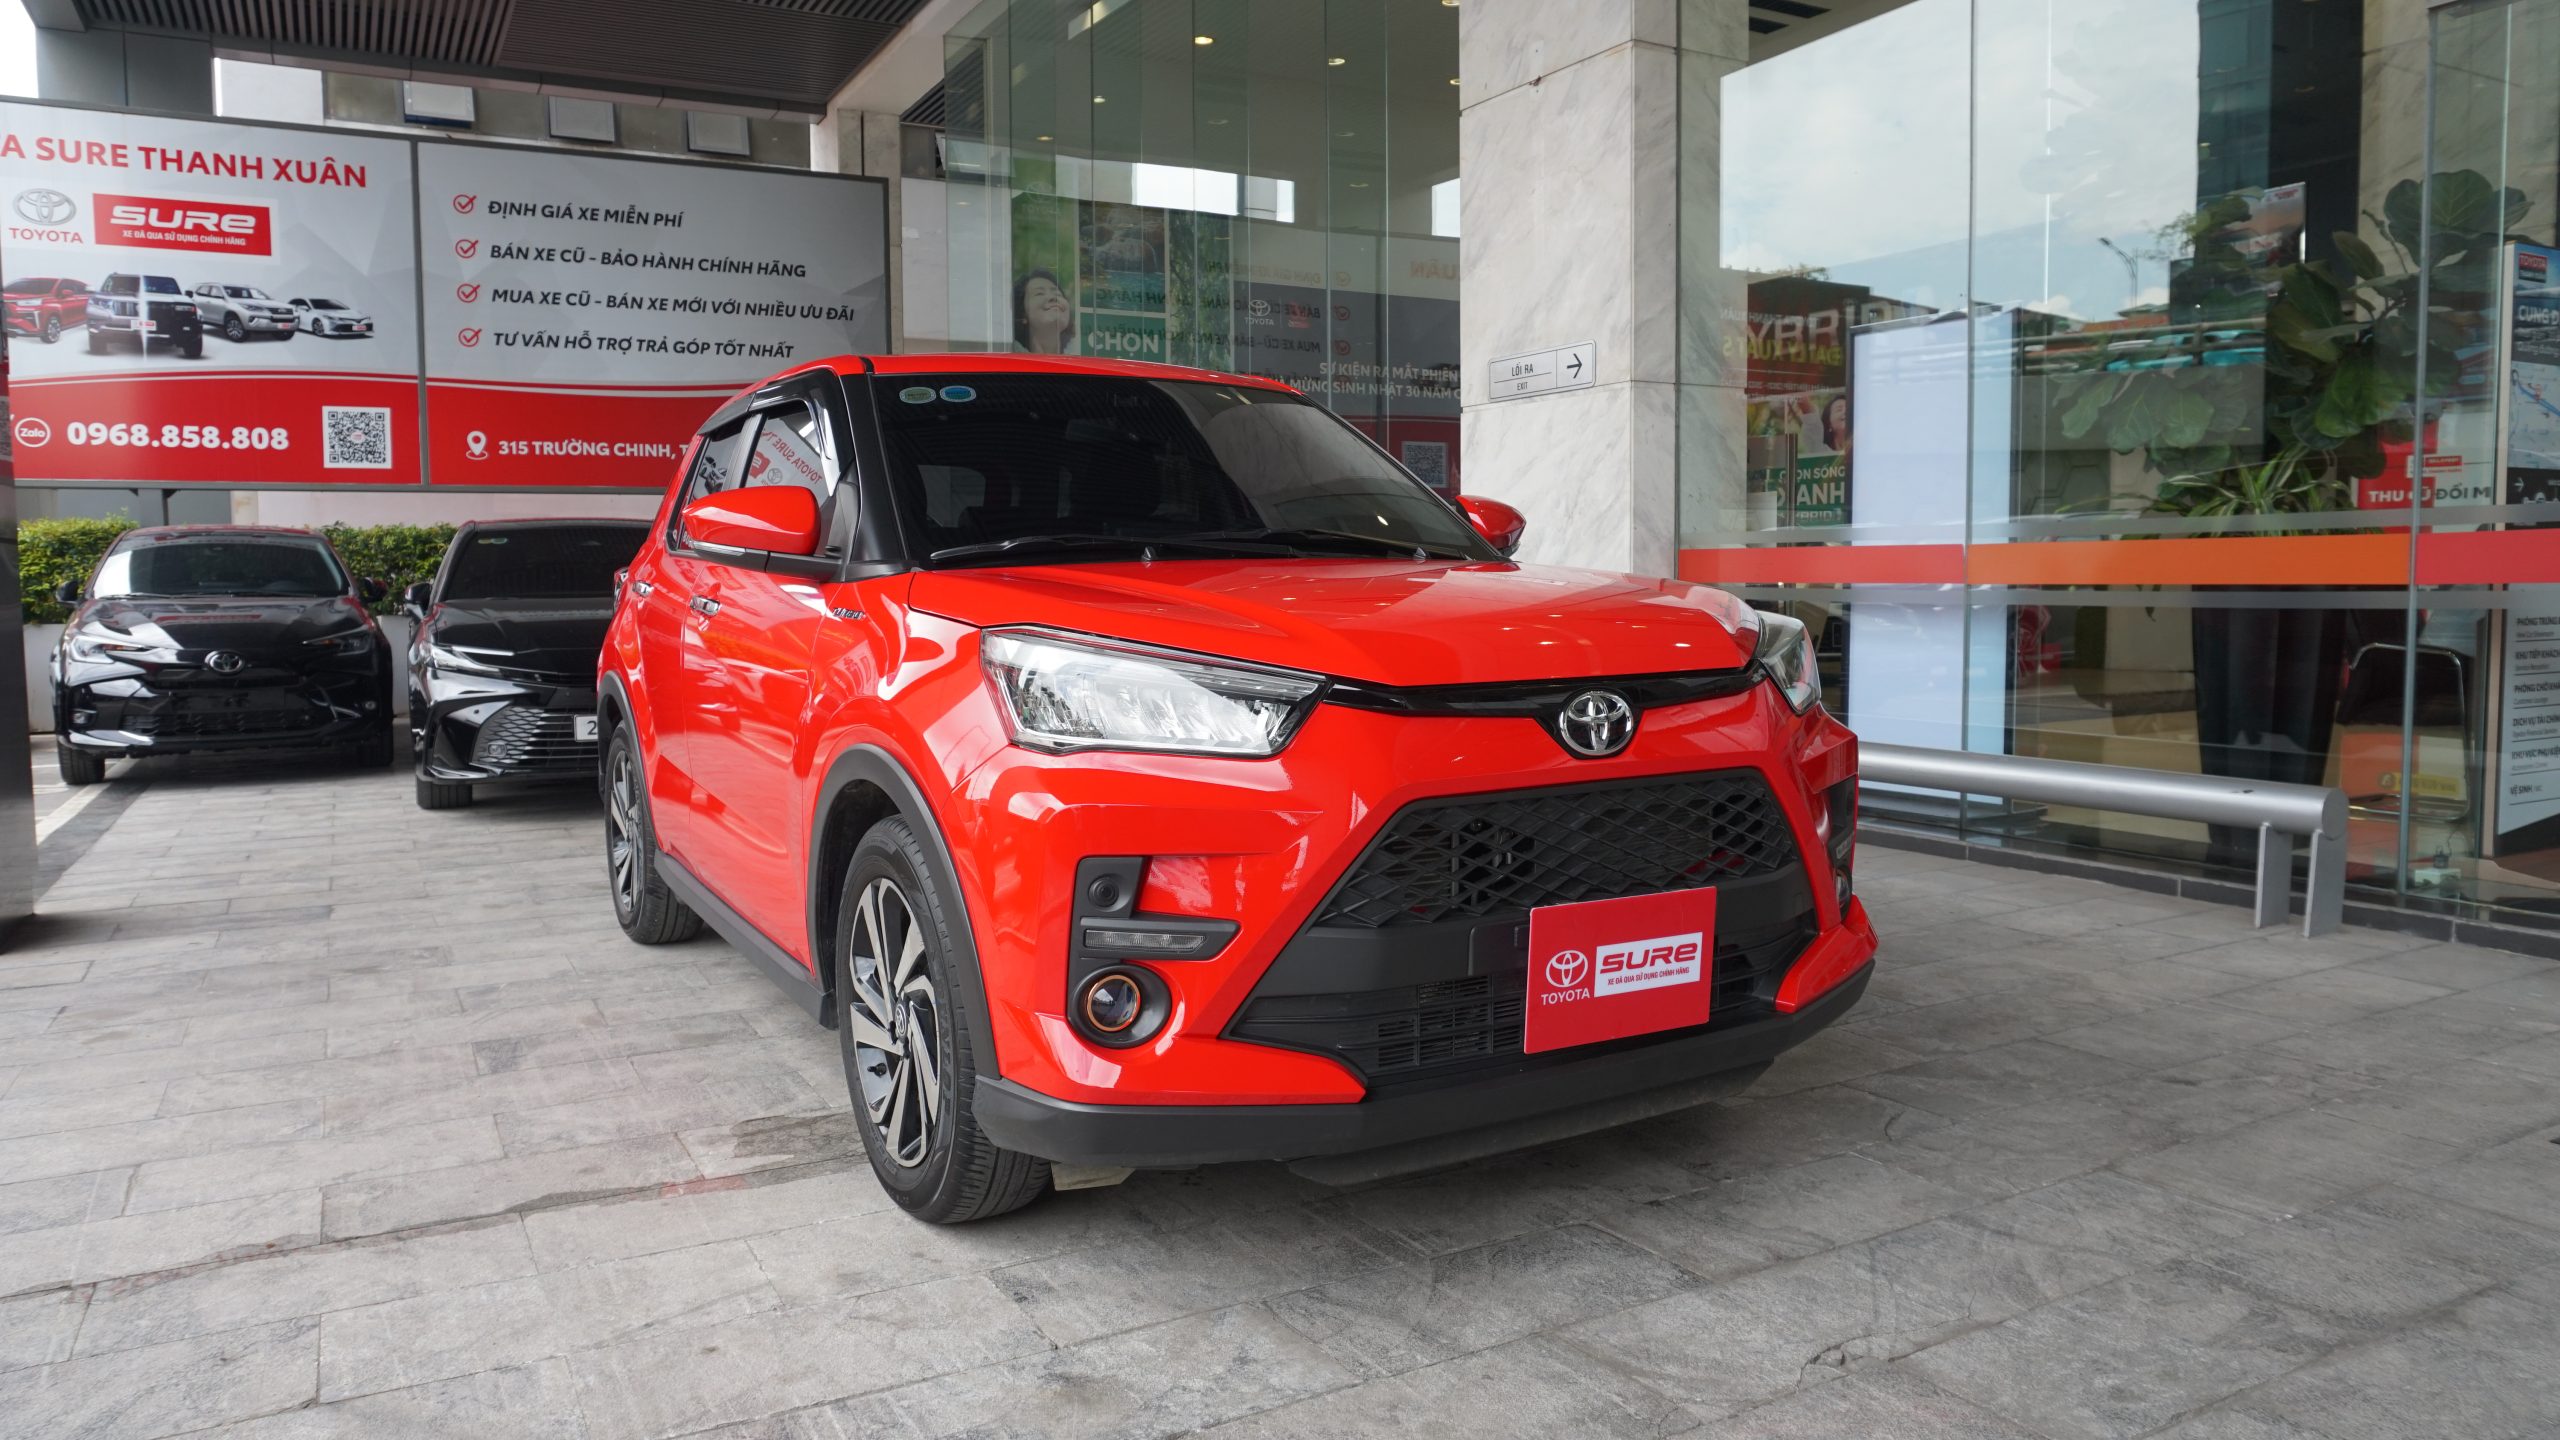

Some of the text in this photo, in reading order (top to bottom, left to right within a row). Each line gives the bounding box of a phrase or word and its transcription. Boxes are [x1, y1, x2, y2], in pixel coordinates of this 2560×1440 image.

[0, 134, 367, 188] A SURE THANH XUÂN
[488, 200, 685, 228] ĐỊNH GIÁ XE MIỄN PHÍ
[9, 227, 84, 245] TOYOTA
[122, 230, 133, 238] XE
[147, 231, 163, 240] QUA
[490, 242, 530, 261] BÁN
[533, 247, 556, 262] XE
[560, 246, 585, 264] CŨ
[600, 248, 638, 267] BẢO
[642, 252, 694, 271] HÀNH
[698, 256, 753, 275] CHÍNH
[757, 260, 806, 278] HÃNG
[491, 288, 535, 304] MUA
[538, 291, 562, 306] XE
[565, 290, 591, 307] CŨ
[606, 292, 643, 310] BÁN
[647, 297, 668, 311] XE
[672, 296, 707, 313] MỚI
[711, 298, 741, 315] VỚI
[744, 299, 796, 318] NHIỀU
[799, 304, 823, 319] ƯU
[826, 305, 854, 321] ĐÃI
[1244, 316, 1275, 326] TOYOTA
[493, 329, 794, 358] TƯ VẤN HỖ TRỢ TRẢ GÓP TỐT NHẤT
[1088, 331, 1159, 357] CHỌN
[1338, 361, 1372, 380] KIỆN
[1373, 366, 1389, 378] RA
[1392, 362, 1419, 379] MẮT
[1511, 362, 1534, 377] LỐI RA
[1332, 382, 1365, 394] SINH
[1368, 383, 1402, 400] NHẬT
[1406, 386, 1420, 398] 30
[1423, 385, 1451, 399] NĂM
[1453, 388, 1461, 399] C
[1517, 381, 1528, 391] EXIT
[20, 427, 46, 438] Zalo
[67, 420, 290, 451] 0968.858.808
[498, 438, 690, 460] 315 TRƯỜNG CHINH, T
[2368, 490, 2405, 503] THU
[2473, 487, 2491, 499] M
[587, 720, 597, 735] 2
[1607, 978, 1615, 986] XE
[1623, 975, 1635, 984] QUA
[1541, 987, 1590, 1005] TOYOTA
